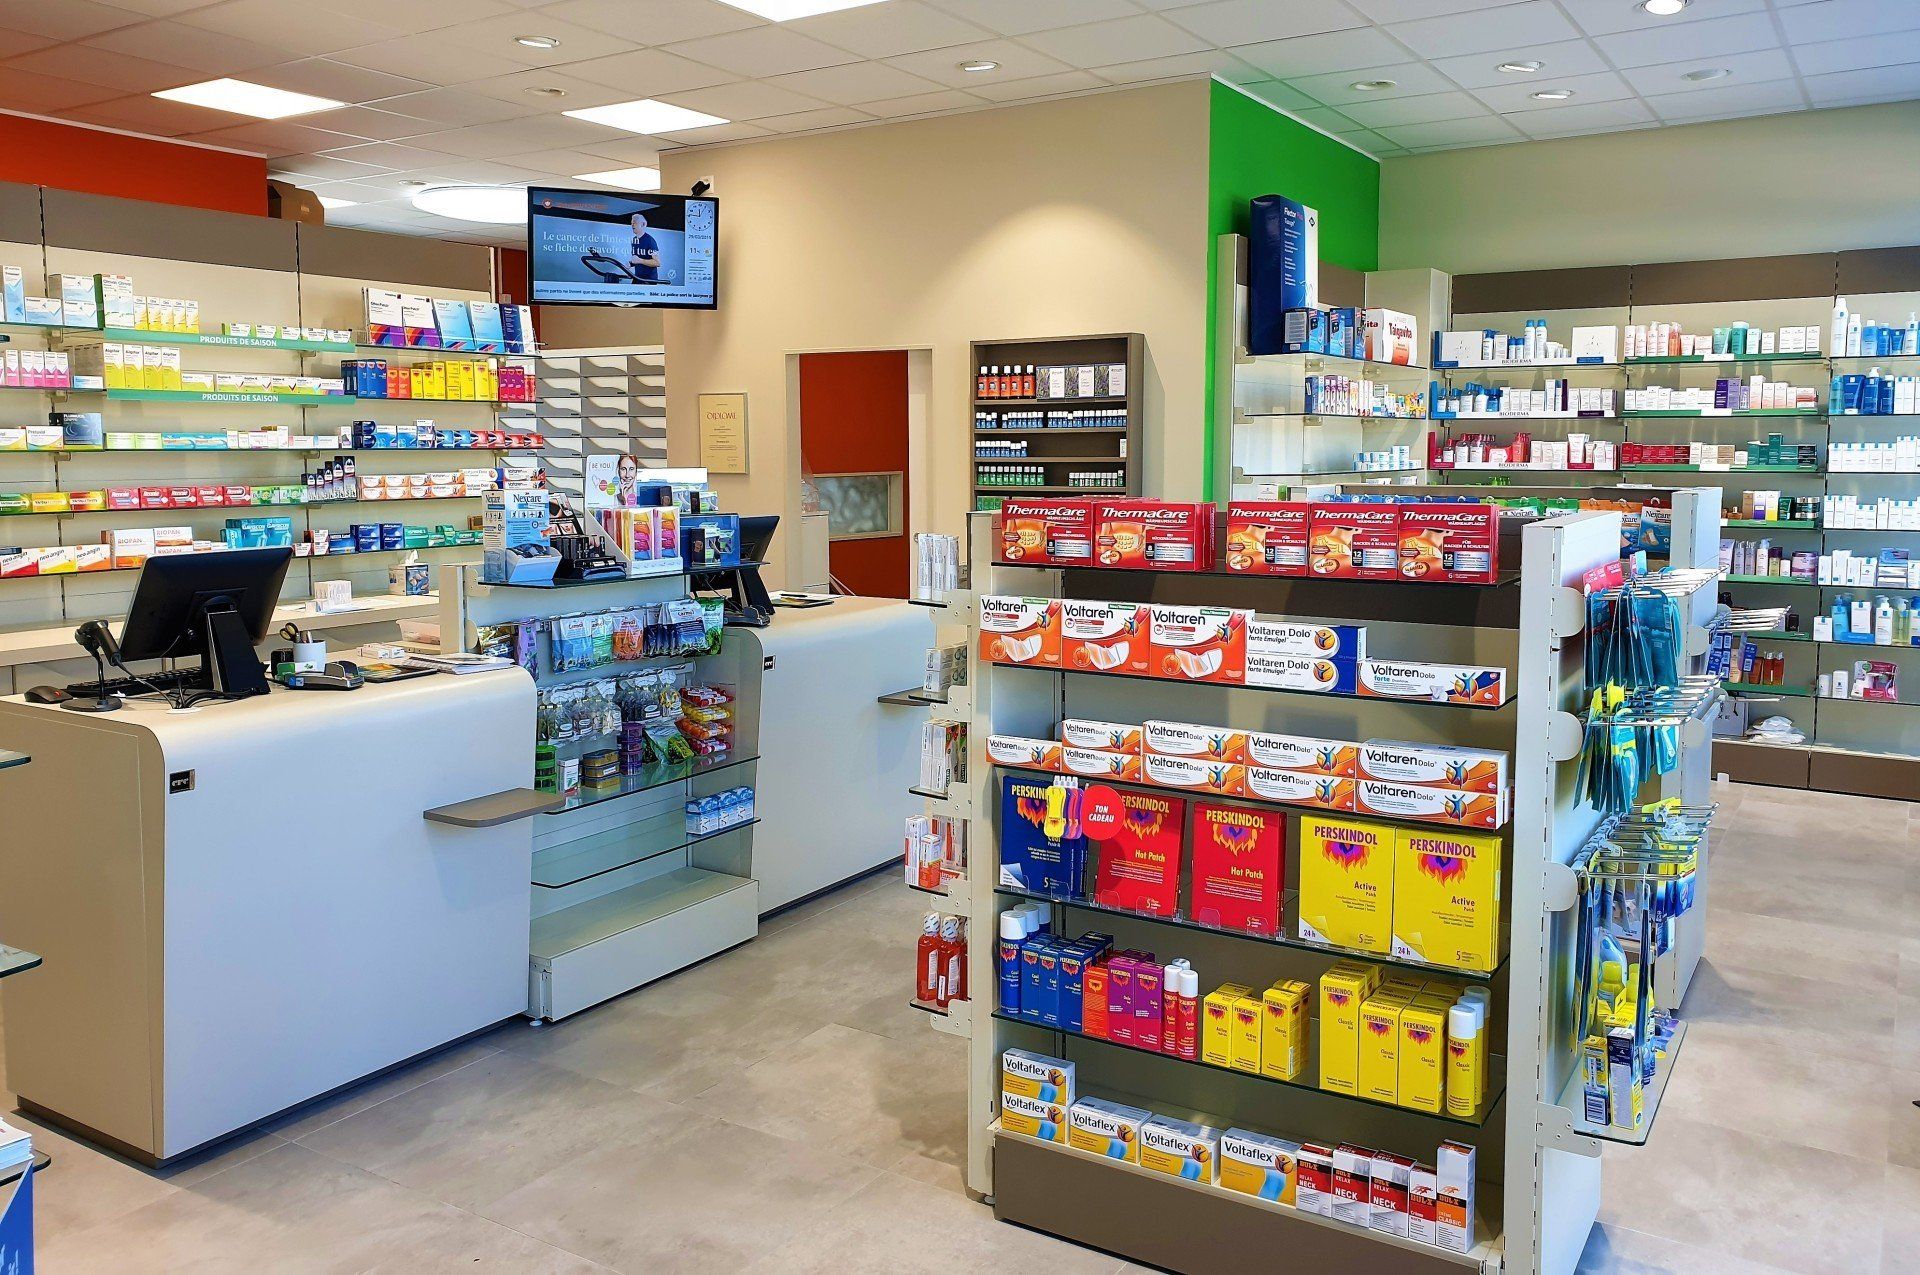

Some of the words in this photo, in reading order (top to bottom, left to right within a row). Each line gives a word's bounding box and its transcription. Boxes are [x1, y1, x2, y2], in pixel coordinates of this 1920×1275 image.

[543, 232, 554, 240] Le
[556, 234, 587, 242] cancer
[588, 234, 599, 242] de
[555, 243, 577, 252] fiche
[1388, 323, 1412, 339] Taigavita
[200, 336, 238, 344] PRODUITS
[251, 338, 277, 346] SAISON
[514, 494, 541, 504] Nexcare
[1006, 504, 1088, 517] ThermaCare
[1101, 507, 1190, 519] ThermaCare
[1230, 509, 1305, 519] ThermaCare
[1314, 510, 1396, 520] ThermaCare
[1404, 512, 1487, 522] ThermaCare
[982, 599, 1028, 613] Voltaren
[1064, 604, 1114, 619] Voltaren
[1153, 609, 1206, 625] Voltaren
[1248, 626, 1286, 636] Voltaren
[1288, 629, 1311, 638] Dolo
[1264, 636, 1288, 644] Emulgel
[1247, 657, 1285, 667] Voltaren
[1287, 660, 1310, 670] Dolo
[1263, 668, 1288, 676] Emulgel
[1371, 664, 1419, 678] Voltaren
[1065, 724, 1096, 734] Voltaren
[1148, 725, 1189, 739] Voltaren
[989, 740, 1018, 750] Voltaren
[1252, 737, 1296, 751] Voltaren
[1065, 749, 1095, 760] Voltaren
[1366, 749, 1417, 765] Voltaren
[1418, 760, 1435, 768] Dolo
[1148, 756, 1189, 769] Voltaren
[1251, 768, 1295, 784] Voltaren
[1012, 785, 1046, 800] PERSKIN
[1365, 782, 1416, 798] Voltaren
[1095, 805, 1109, 814] TON
[1122, 796, 1169, 813] ERSKINDOL
[1089, 813, 1114, 823] CADEAU
[1206, 810, 1265, 828] PERSKINDOL
[1314, 826, 1377, 845] PERSKINDOL
[1410, 838, 1476, 858] PERSKINDOL
[1136, 850, 1147, 859] Hot
[1148, 852, 1165, 862] Patch
[1231, 867, 1243, 876] Hot
[1245, 869, 1263, 879] Patch
[1354, 881, 1377, 892] Active
[1451, 896, 1475, 907] Active
[1359, 933, 1364, 943] 5
[1456, 950, 1461, 960] 5
[1324, 986, 1353, 996] PERSKINDOL
[1205, 1002, 1228, 1011] PERSKINDOL
[1363, 1014, 1394, 1025] PERSKINDOL
[1404, 1022, 1436, 1033] PERSKINDOL
[1005, 1058, 1045, 1077] Voltaflex
[1005, 1096, 1045, 1114] Voltaflex
[1073, 1113, 1115, 1132] Voltaflex
[1144, 1132, 1189, 1151] Voltaflex
[1225, 1141, 1272, 1162] Voltaflex
[1300, 1180, 1316, 1190] NECK
[1335, 1187, 1358, 1200] NECK
[1411, 1193, 1433, 1206] DUL-X
[1438, 1194, 1460, 1205] DUL-X
[1373, 1196, 1396, 1209] NECK
[1438, 1216, 1461, 1226] CLASSIC
